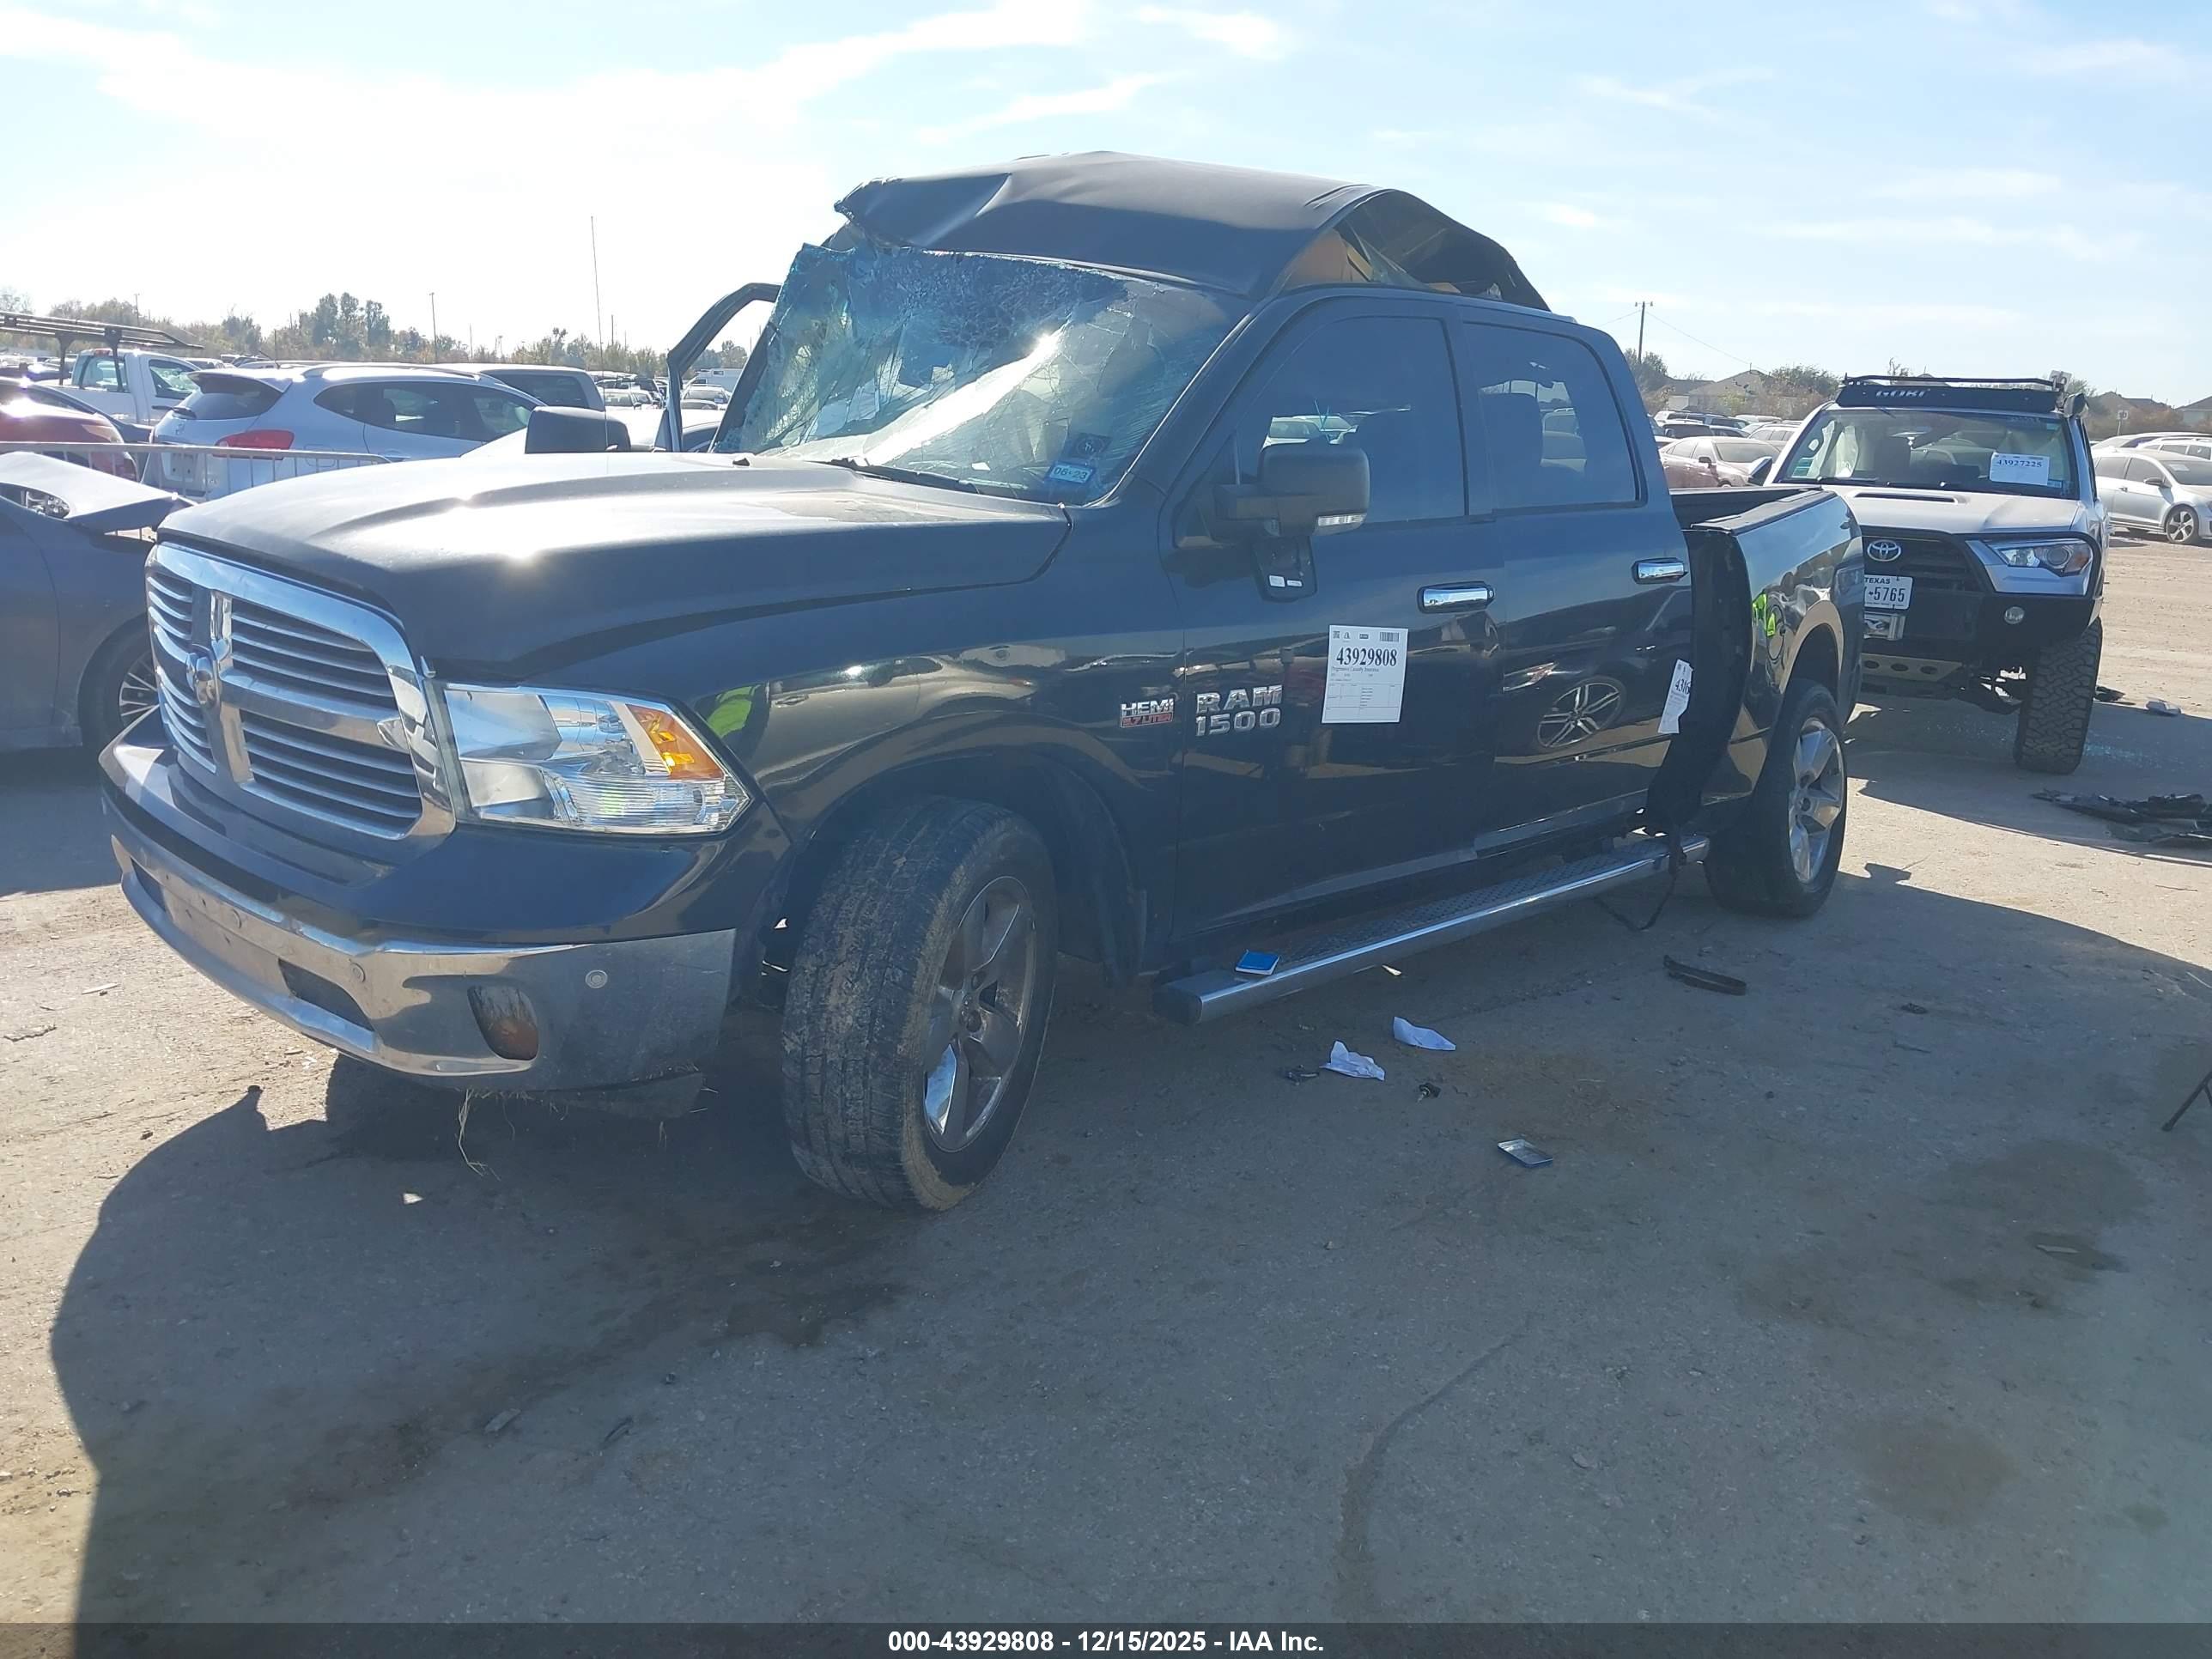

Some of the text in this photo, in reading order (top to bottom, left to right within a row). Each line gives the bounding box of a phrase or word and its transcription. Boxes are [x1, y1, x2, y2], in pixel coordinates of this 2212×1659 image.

[1997, 459, 2043, 468] 43927225
[1336, 647, 1397, 666] 43929808
[1121, 698, 1174, 716] HEMI
[1196, 684, 1283, 714] RAM
[1195, 708, 1281, 737] 1500
